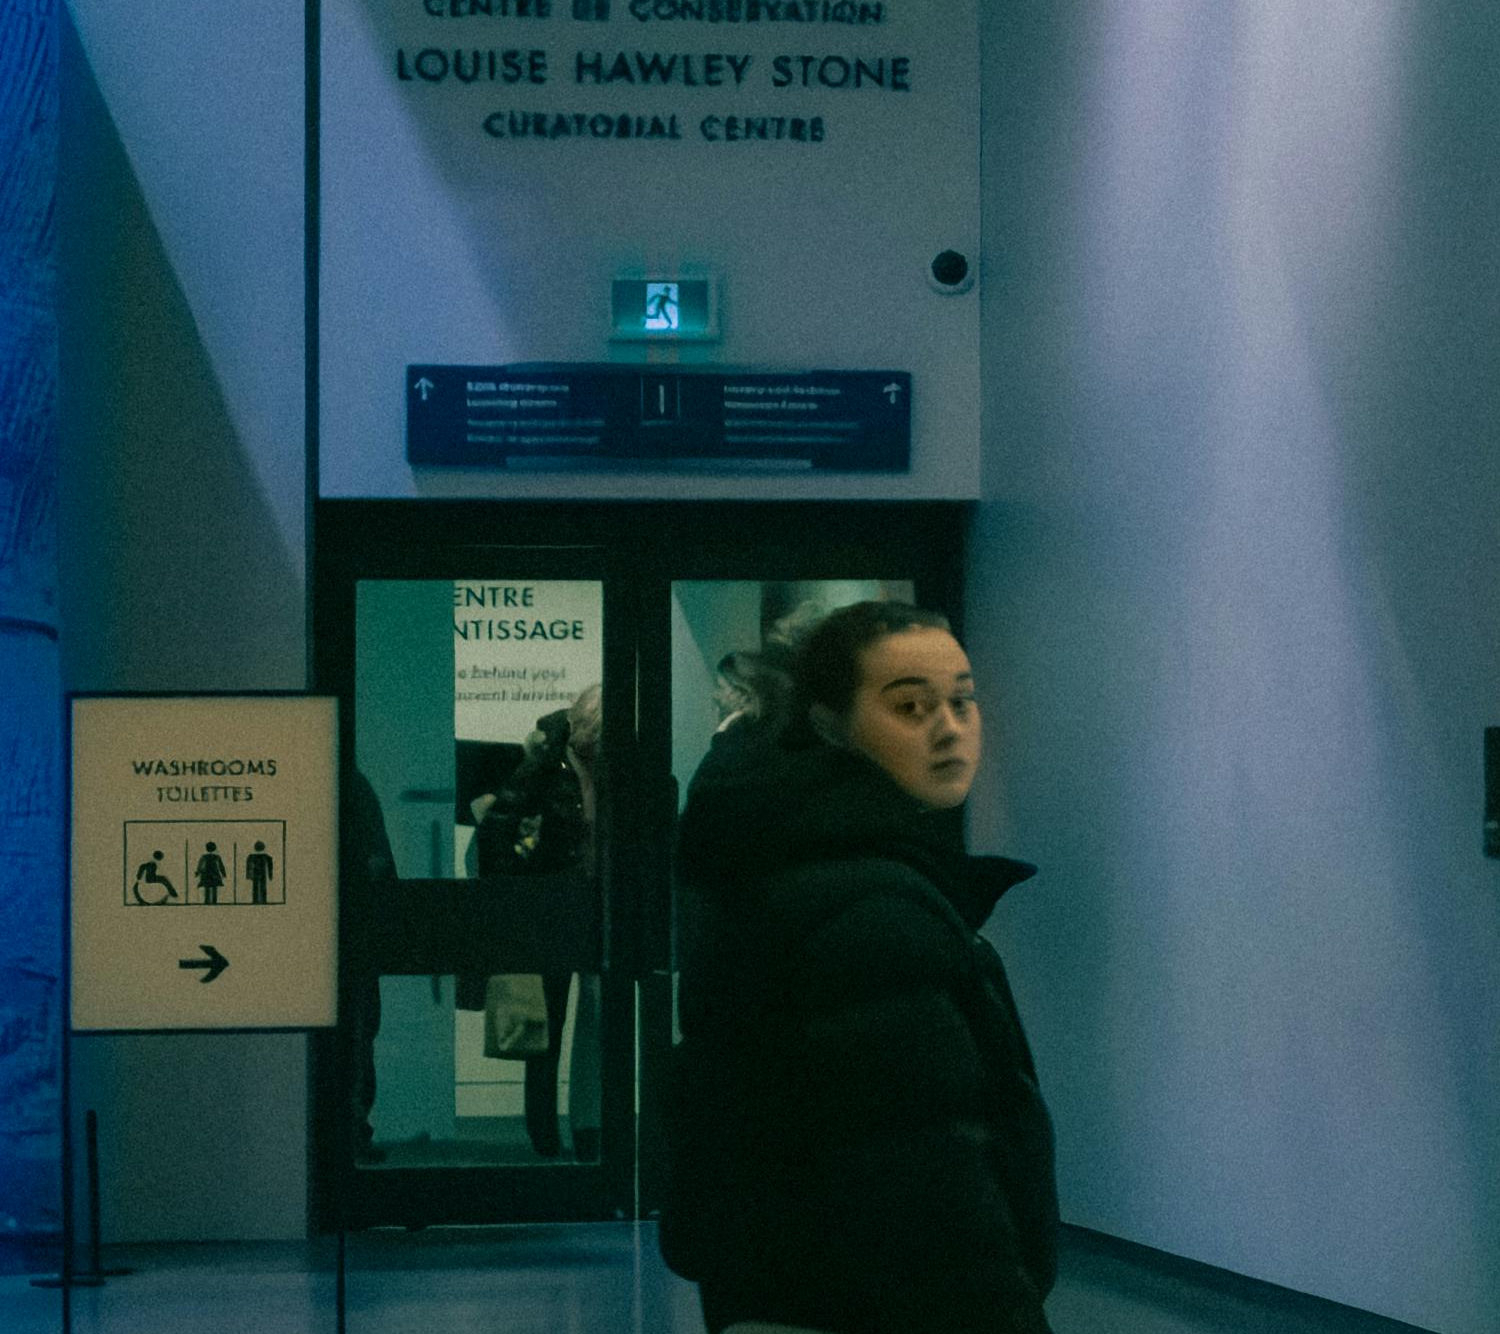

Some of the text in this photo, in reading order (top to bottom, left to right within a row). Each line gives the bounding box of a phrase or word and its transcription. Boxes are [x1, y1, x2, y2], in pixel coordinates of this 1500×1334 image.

[397, 48, 910, 92] LOUISE HAWLEY STONE
[482, 111, 825, 143] CURATORIAL CENTRE
[132, 758, 278, 777] WASHROOMS
[156, 785, 254, 803] TOILETTES
